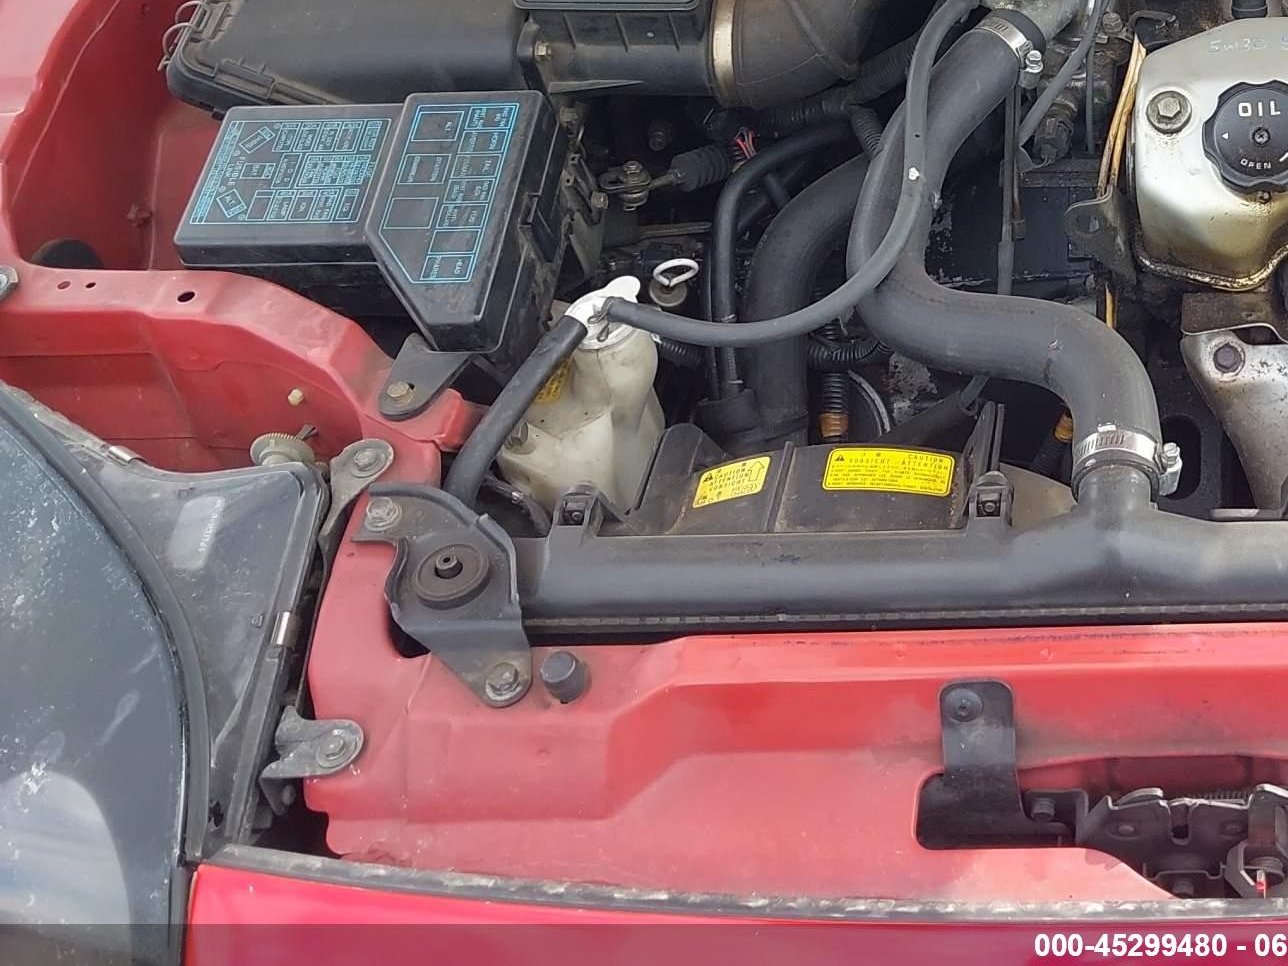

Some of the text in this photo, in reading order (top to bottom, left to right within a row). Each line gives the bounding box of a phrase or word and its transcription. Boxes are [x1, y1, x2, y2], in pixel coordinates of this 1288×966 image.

[1238, 100, 1281, 117] OIL
[1240, 158, 1272, 170] OPEN
[908, 454, 944, 463] CAUTION
[901, 460, 948, 471] ATTENTION
[715, 467, 746, 480] CAUTION
